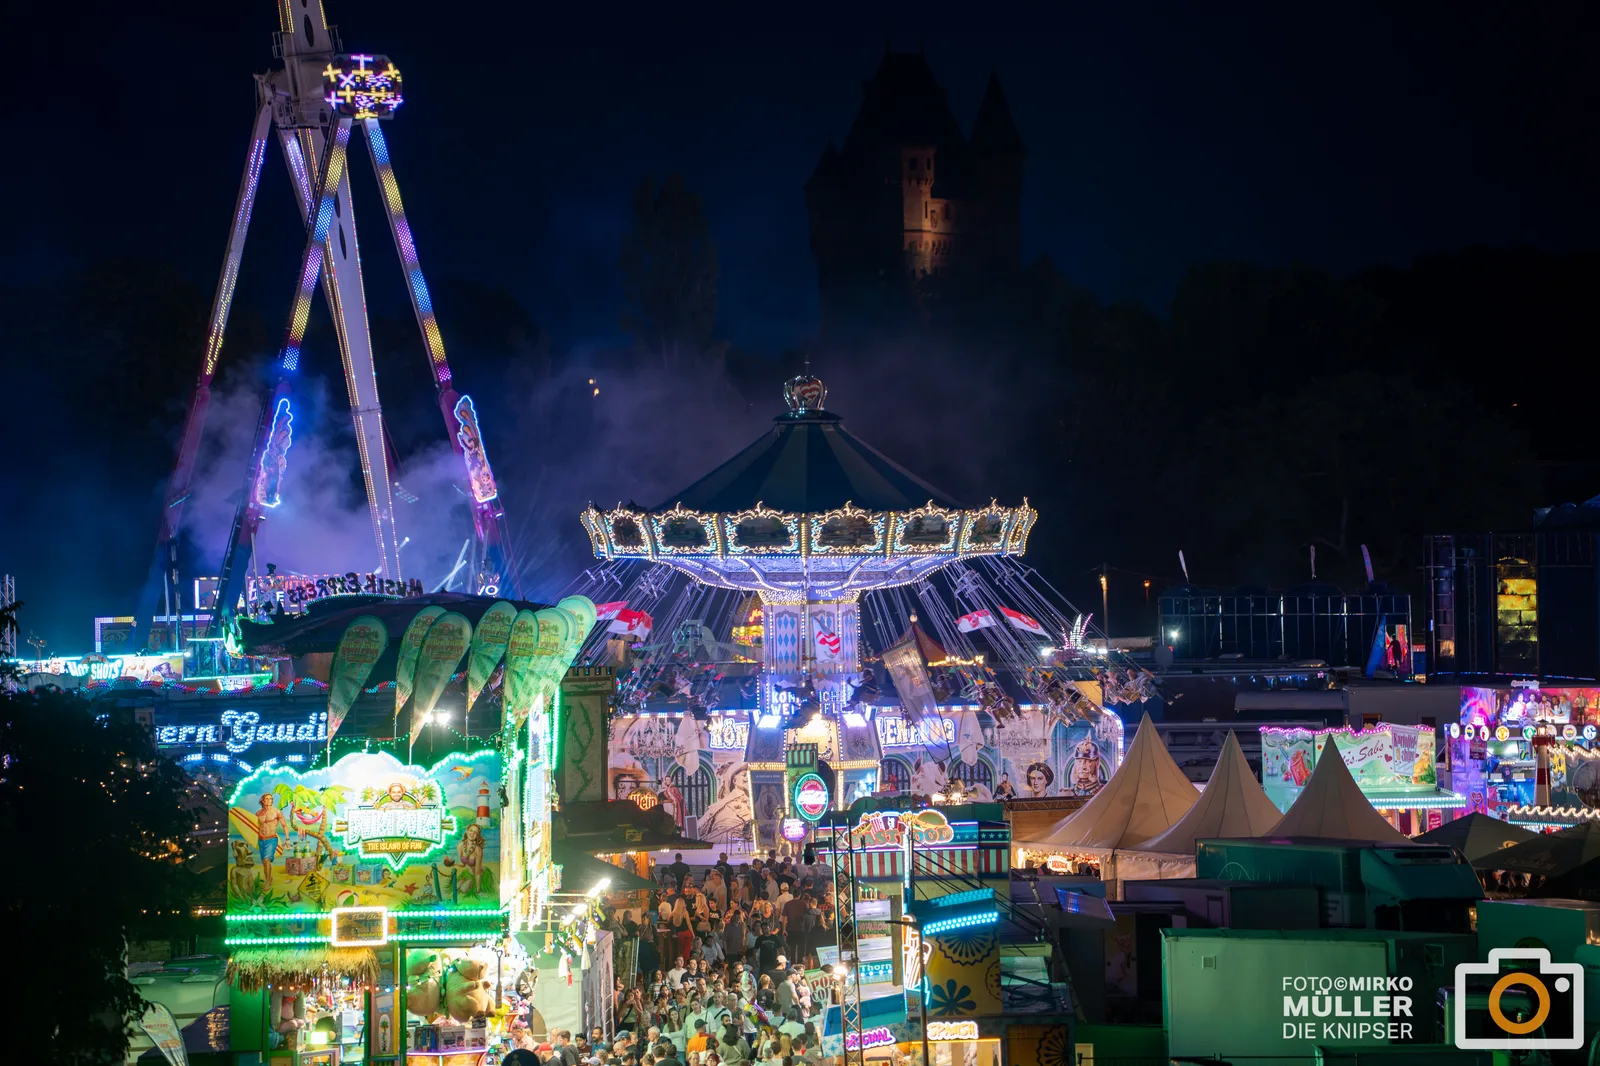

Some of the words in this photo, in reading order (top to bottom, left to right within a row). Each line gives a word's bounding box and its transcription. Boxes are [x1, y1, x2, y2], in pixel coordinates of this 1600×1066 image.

[221, 710, 329, 753] Gaudi
[367, 842, 379, 851] THE
[379, 842, 401, 851] ISLAND
[401, 842, 410, 851] OF
[410, 842, 422, 850] FUN
